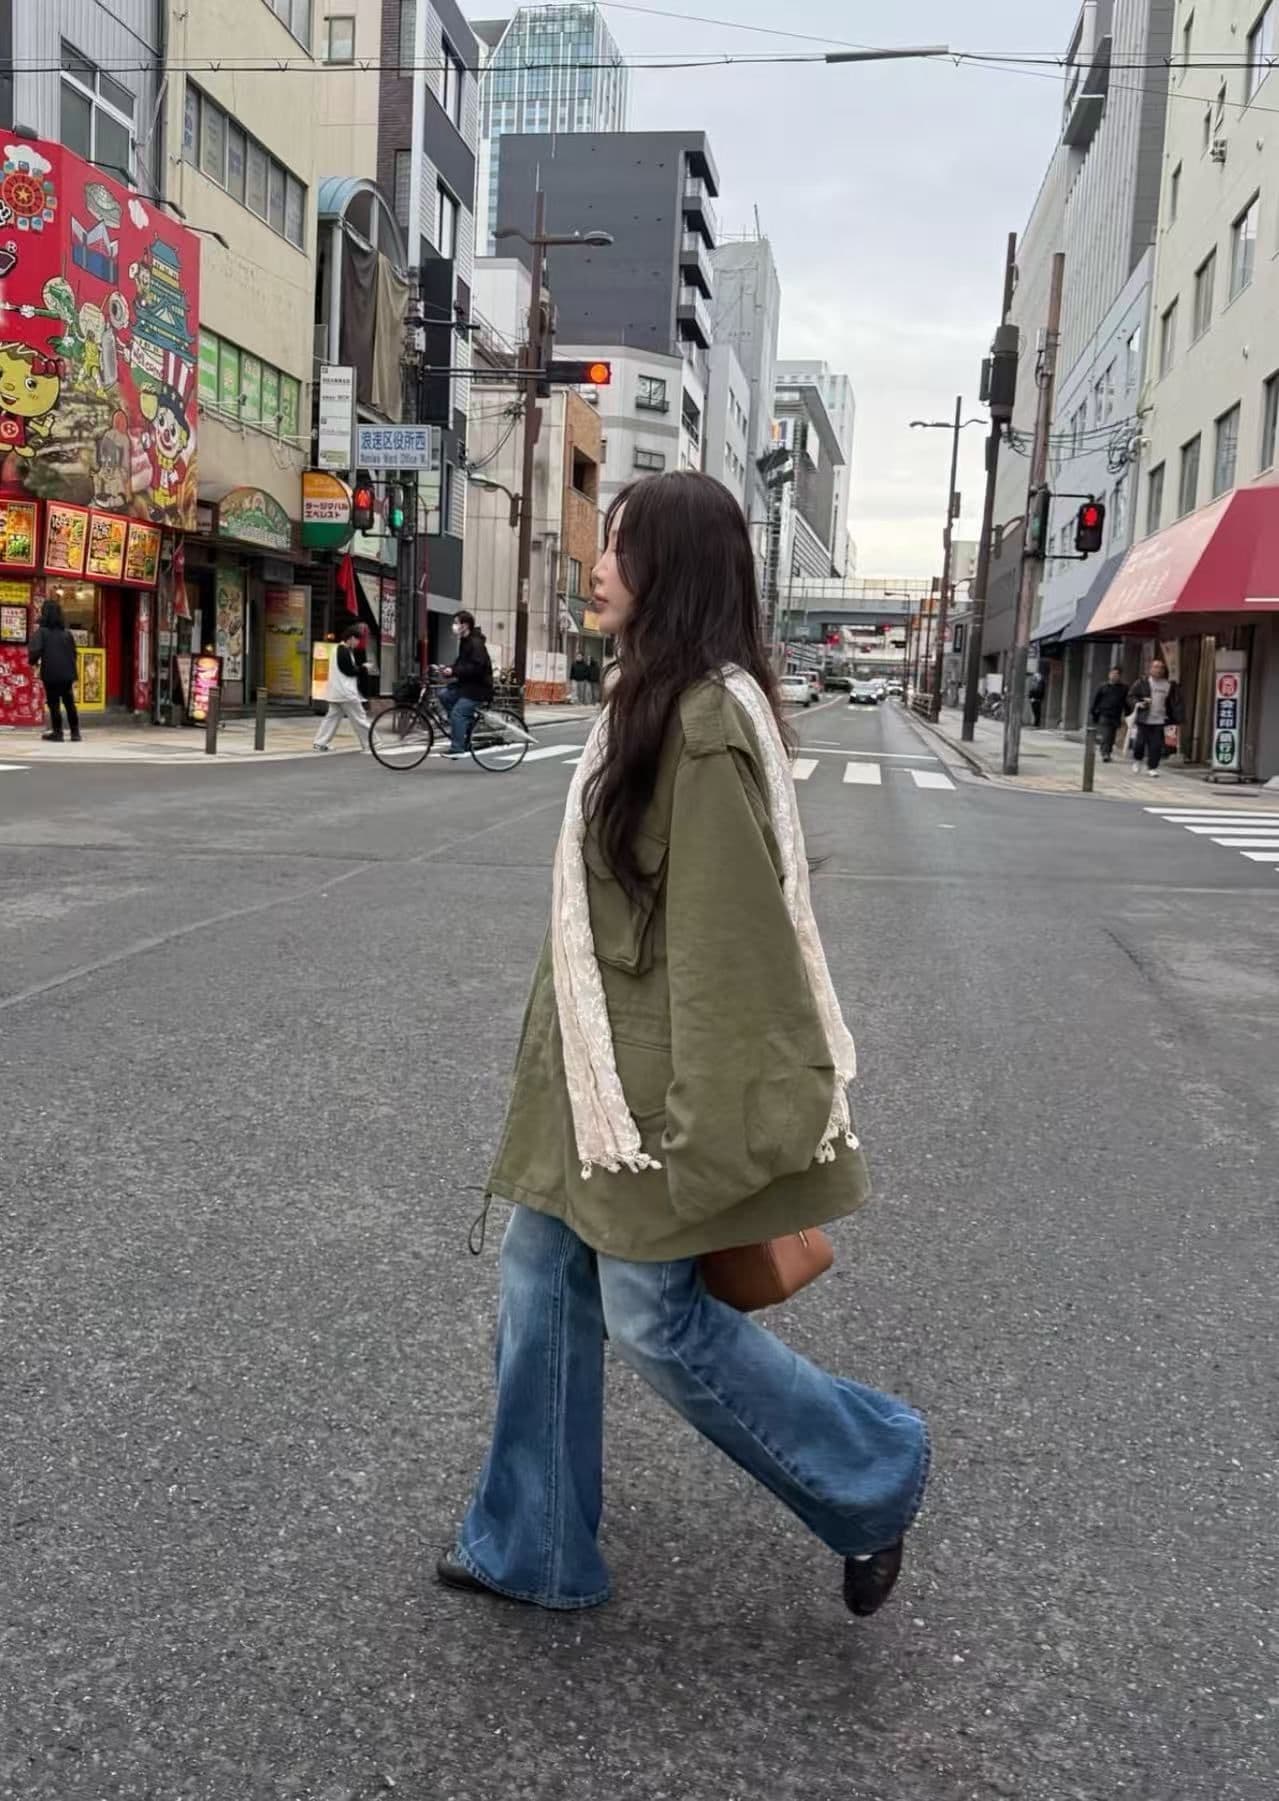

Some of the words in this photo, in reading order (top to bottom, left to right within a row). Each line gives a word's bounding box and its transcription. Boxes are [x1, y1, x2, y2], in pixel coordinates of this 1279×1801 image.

[361, 431, 426, 449] 浪速区役所西
